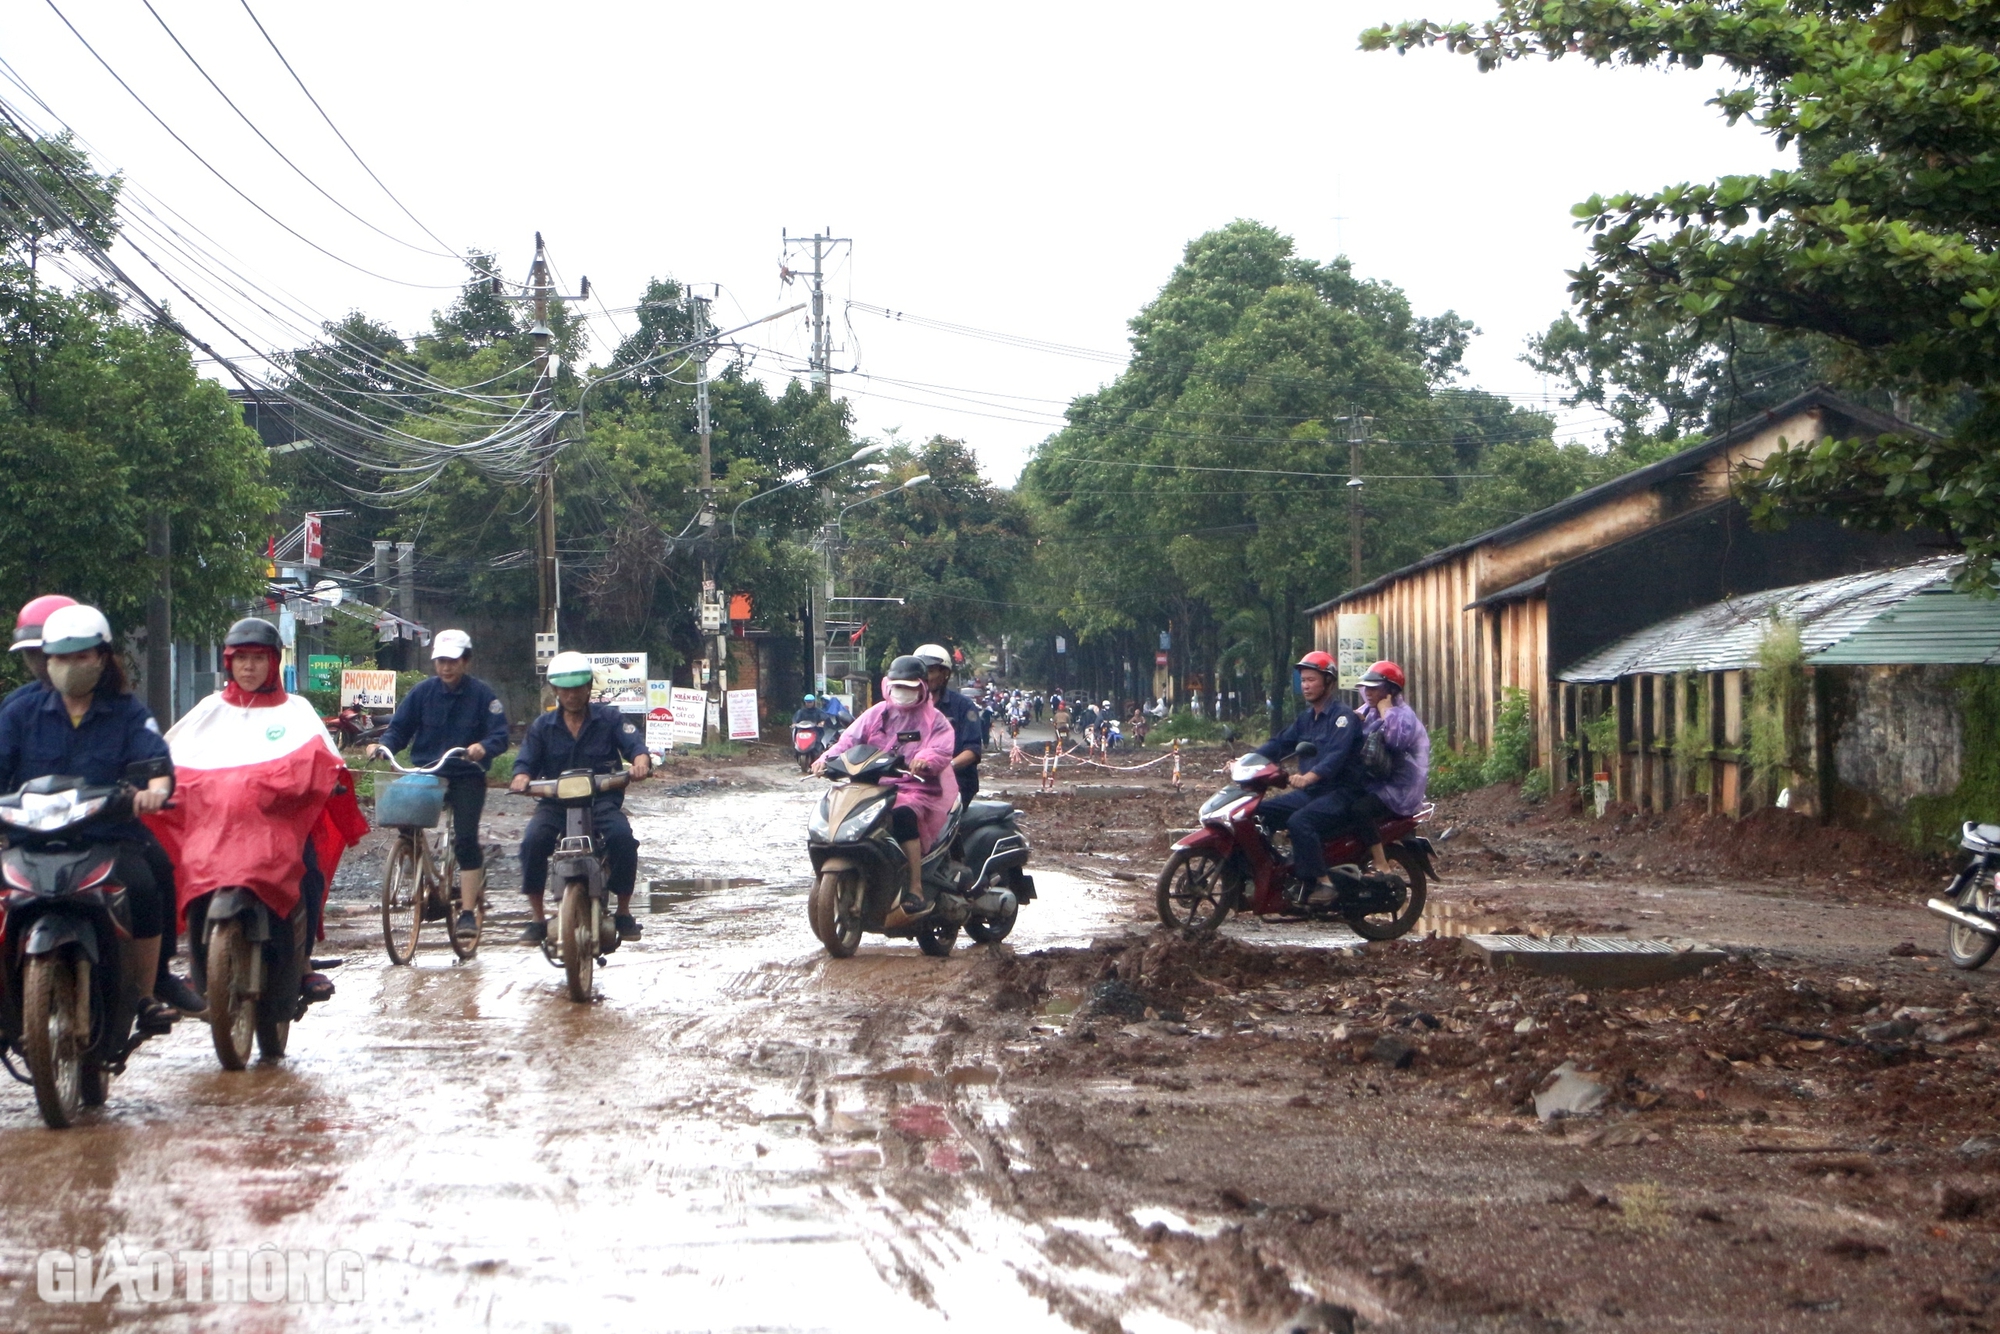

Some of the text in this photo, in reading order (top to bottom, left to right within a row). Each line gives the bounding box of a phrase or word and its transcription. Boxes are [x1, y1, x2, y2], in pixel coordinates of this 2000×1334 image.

[345, 673, 394, 690] PHOTOCOPY
[674, 693, 703, 702] NHẬN SỬA
